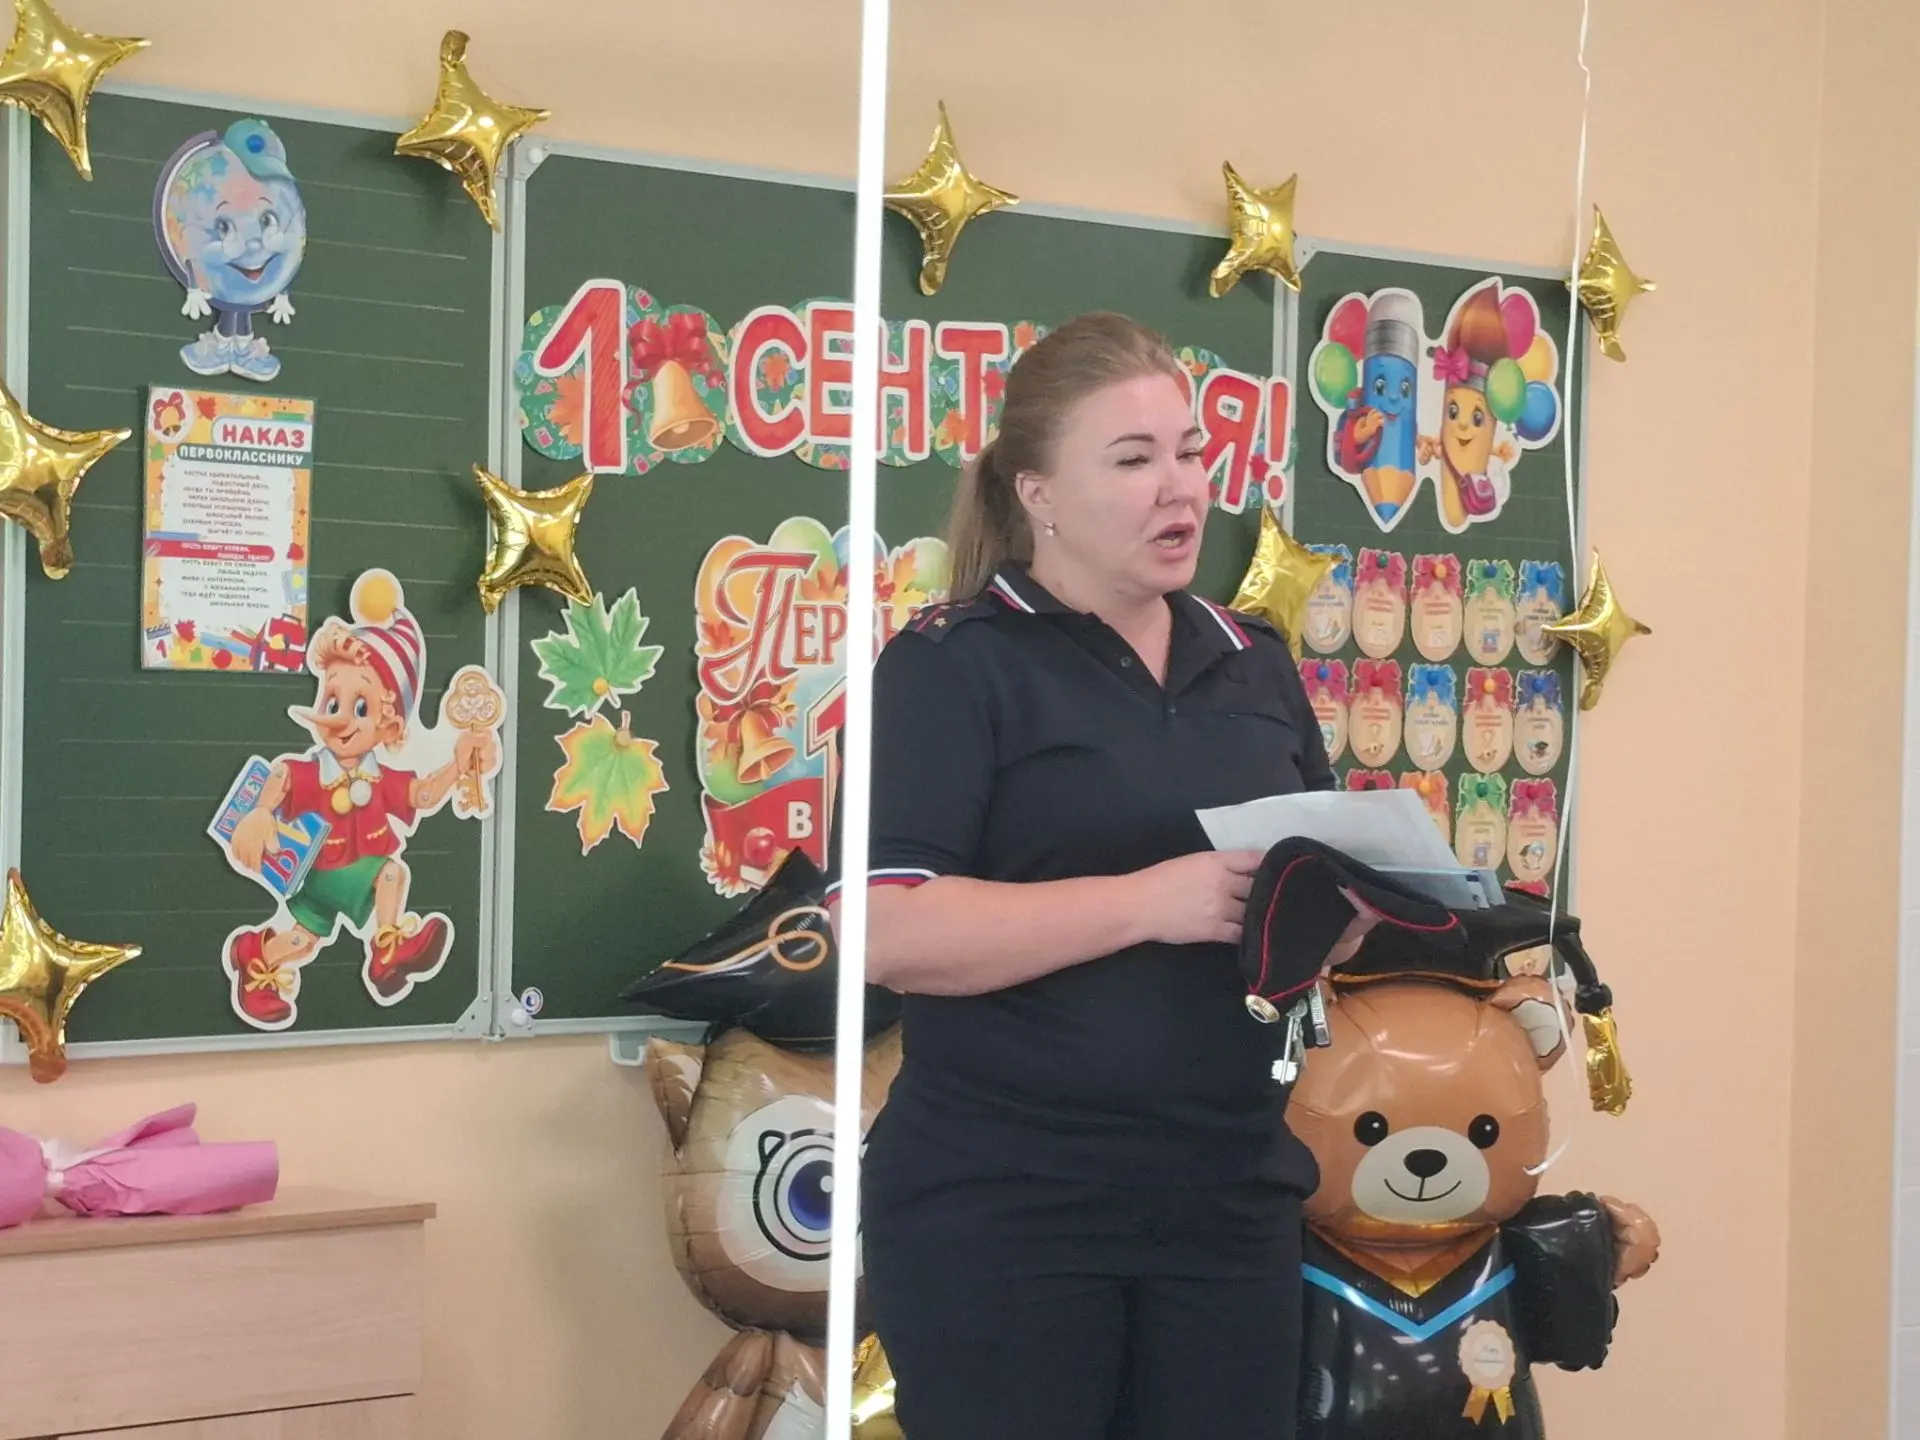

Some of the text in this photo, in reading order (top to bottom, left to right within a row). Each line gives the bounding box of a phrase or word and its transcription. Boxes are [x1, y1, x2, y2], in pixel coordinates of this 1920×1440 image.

[537, 280, 1290, 512] 1 СЕНТЯ!
[222, 424, 305, 448] НАКАЗ
[179, 446, 304, 466] ПЕРВОКЛАССНИКУ
[787, 801, 813, 839] В
